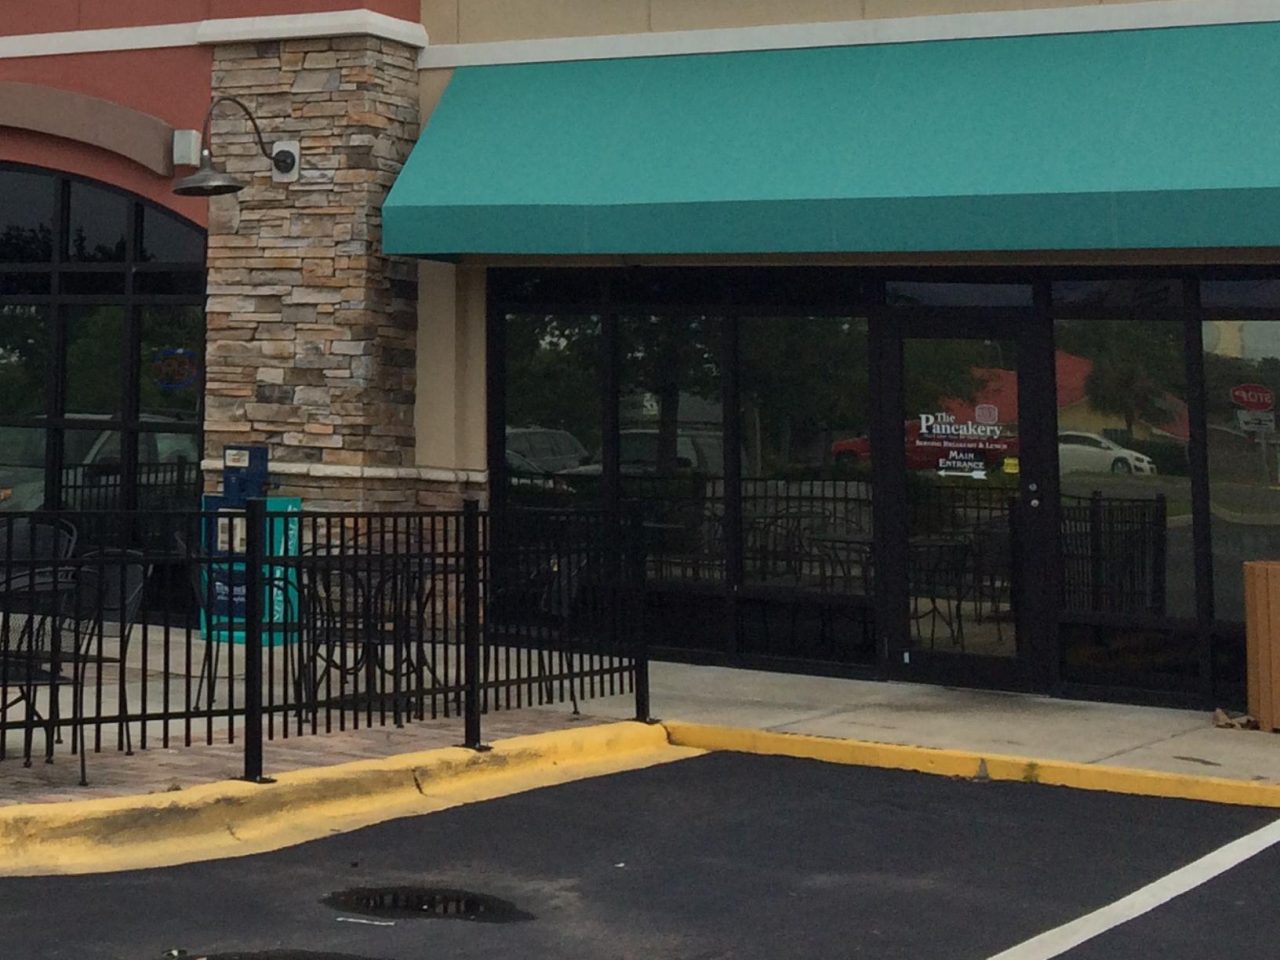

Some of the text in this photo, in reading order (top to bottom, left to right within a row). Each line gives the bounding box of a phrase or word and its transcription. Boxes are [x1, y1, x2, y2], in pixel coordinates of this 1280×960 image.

[935, 412, 955, 423] The
[919, 414, 1002, 438] Pancakery
[949, 450, 974, 460] MAIN
[939, 459, 985, 469] ENTRANCE
